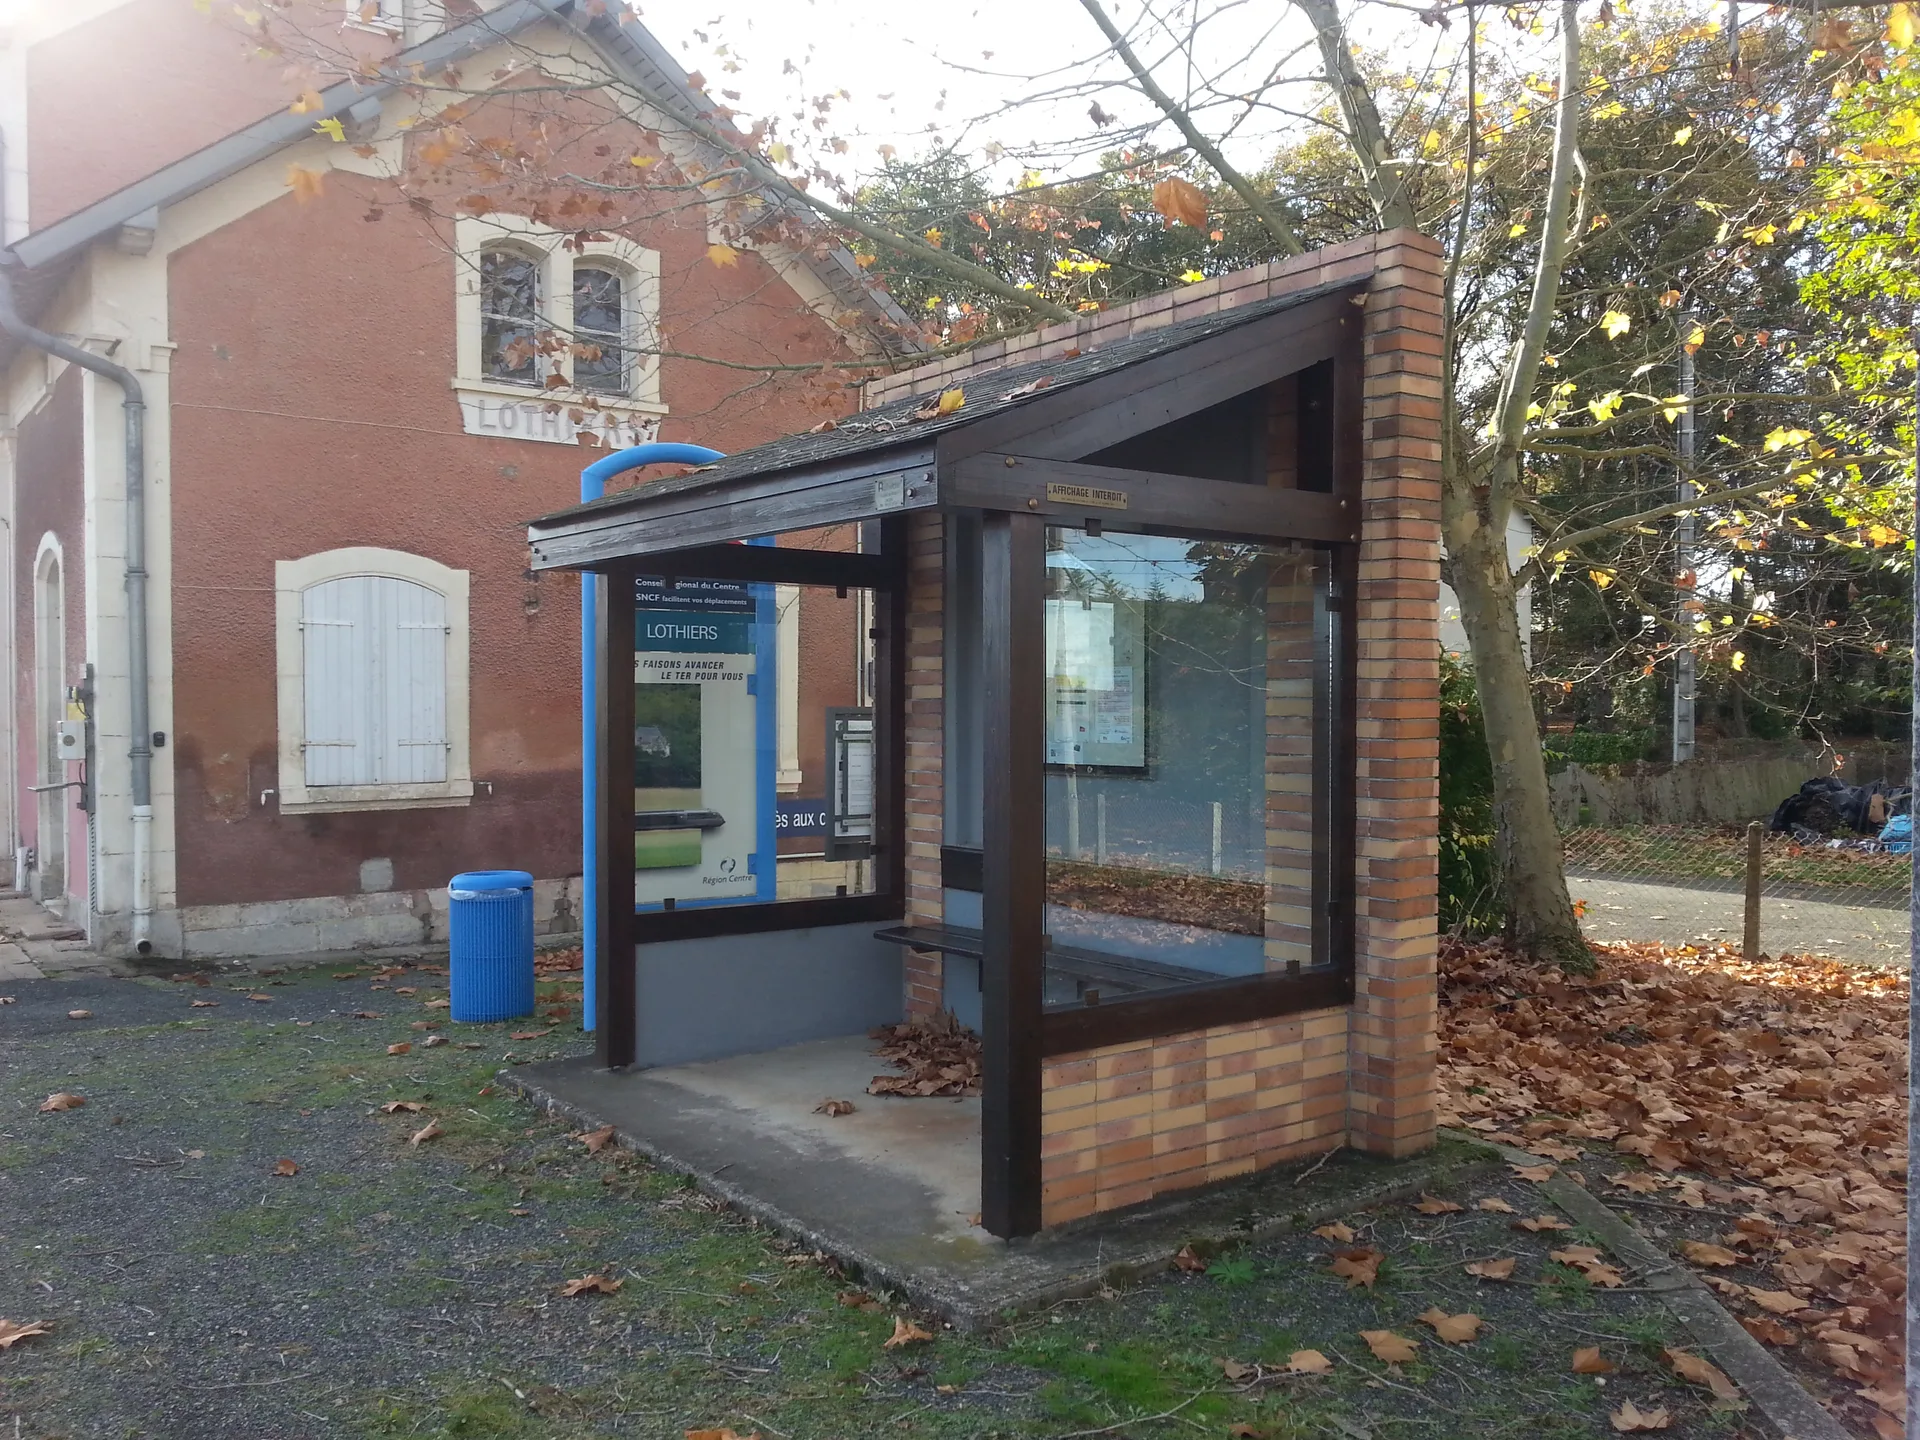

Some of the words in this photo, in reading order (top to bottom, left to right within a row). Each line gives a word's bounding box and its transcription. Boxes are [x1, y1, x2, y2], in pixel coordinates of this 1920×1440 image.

[1052, 484, 1089, 498] AFFICHAGE
[1092, 489, 1123, 502] INTERDIT
[712, 582, 740, 590] Centre
[635, 593, 660, 601] SNCF
[647, 624, 718, 640] LOTHIERS
[643, 660, 681, 669] FAISONS
[685, 661, 724, 670] AVANCER
[661, 671, 672, 680] LE
[675, 671, 692, 680] TER
[694, 672, 719, 681] POUR
[721, 673, 744, 681] VOUS
[793, 812, 816, 828] aux
[702, 876, 727, 886] Région
[728, 874, 752, 882] Centre
